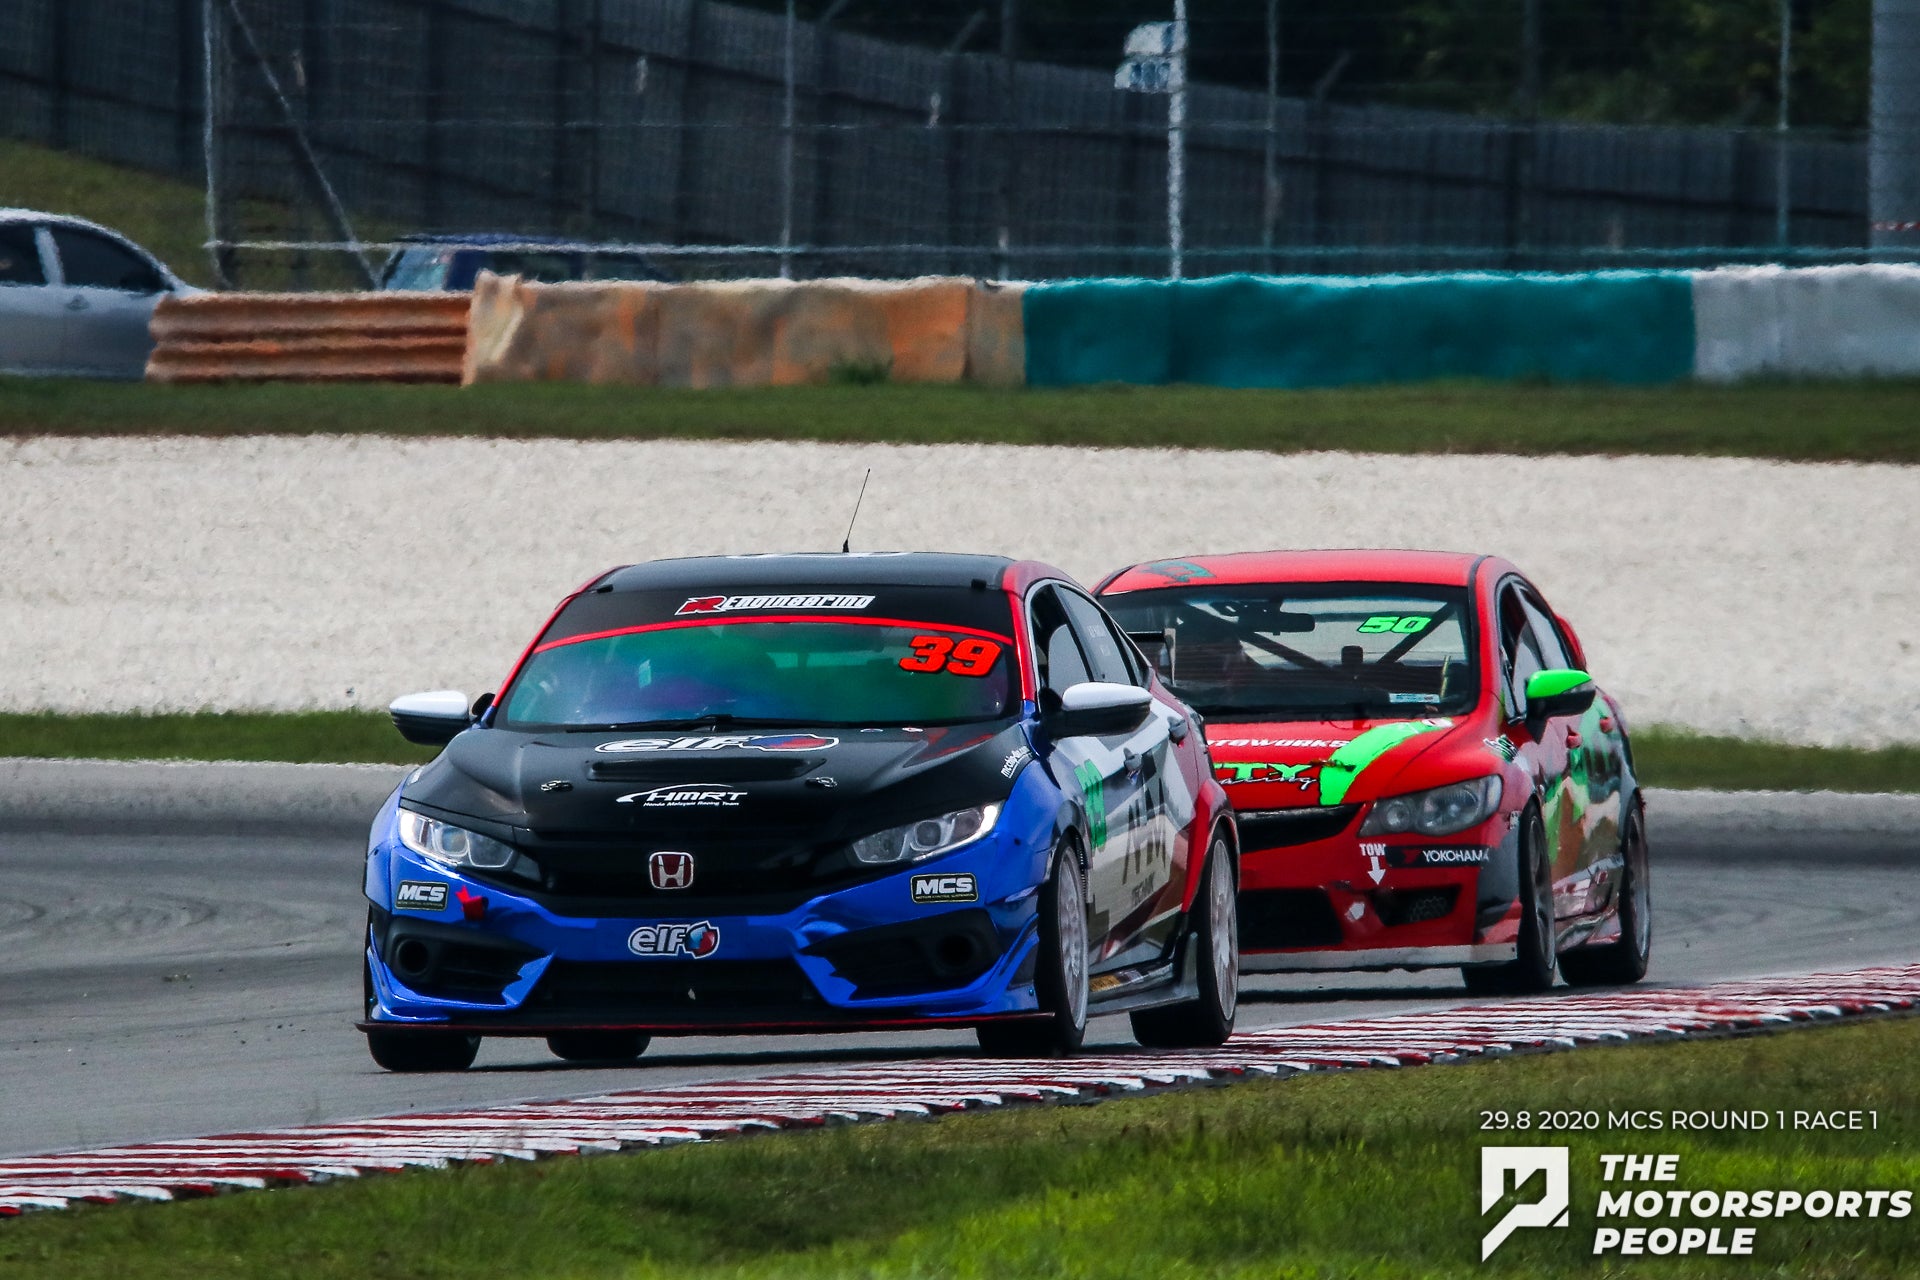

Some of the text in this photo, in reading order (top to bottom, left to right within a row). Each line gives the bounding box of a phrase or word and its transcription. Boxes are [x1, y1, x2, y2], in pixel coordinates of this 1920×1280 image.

[1358, 616, 1432, 633] 50
[899, 635, 1003, 677] 39
[1213, 762, 1313, 780] TY
[646, 791, 748, 802] HMRT
[1359, 843, 1386, 857] TOW
[398, 884, 446, 902] MCS
[915, 877, 973, 895] MCS
[630, 926, 687, 953] elf
